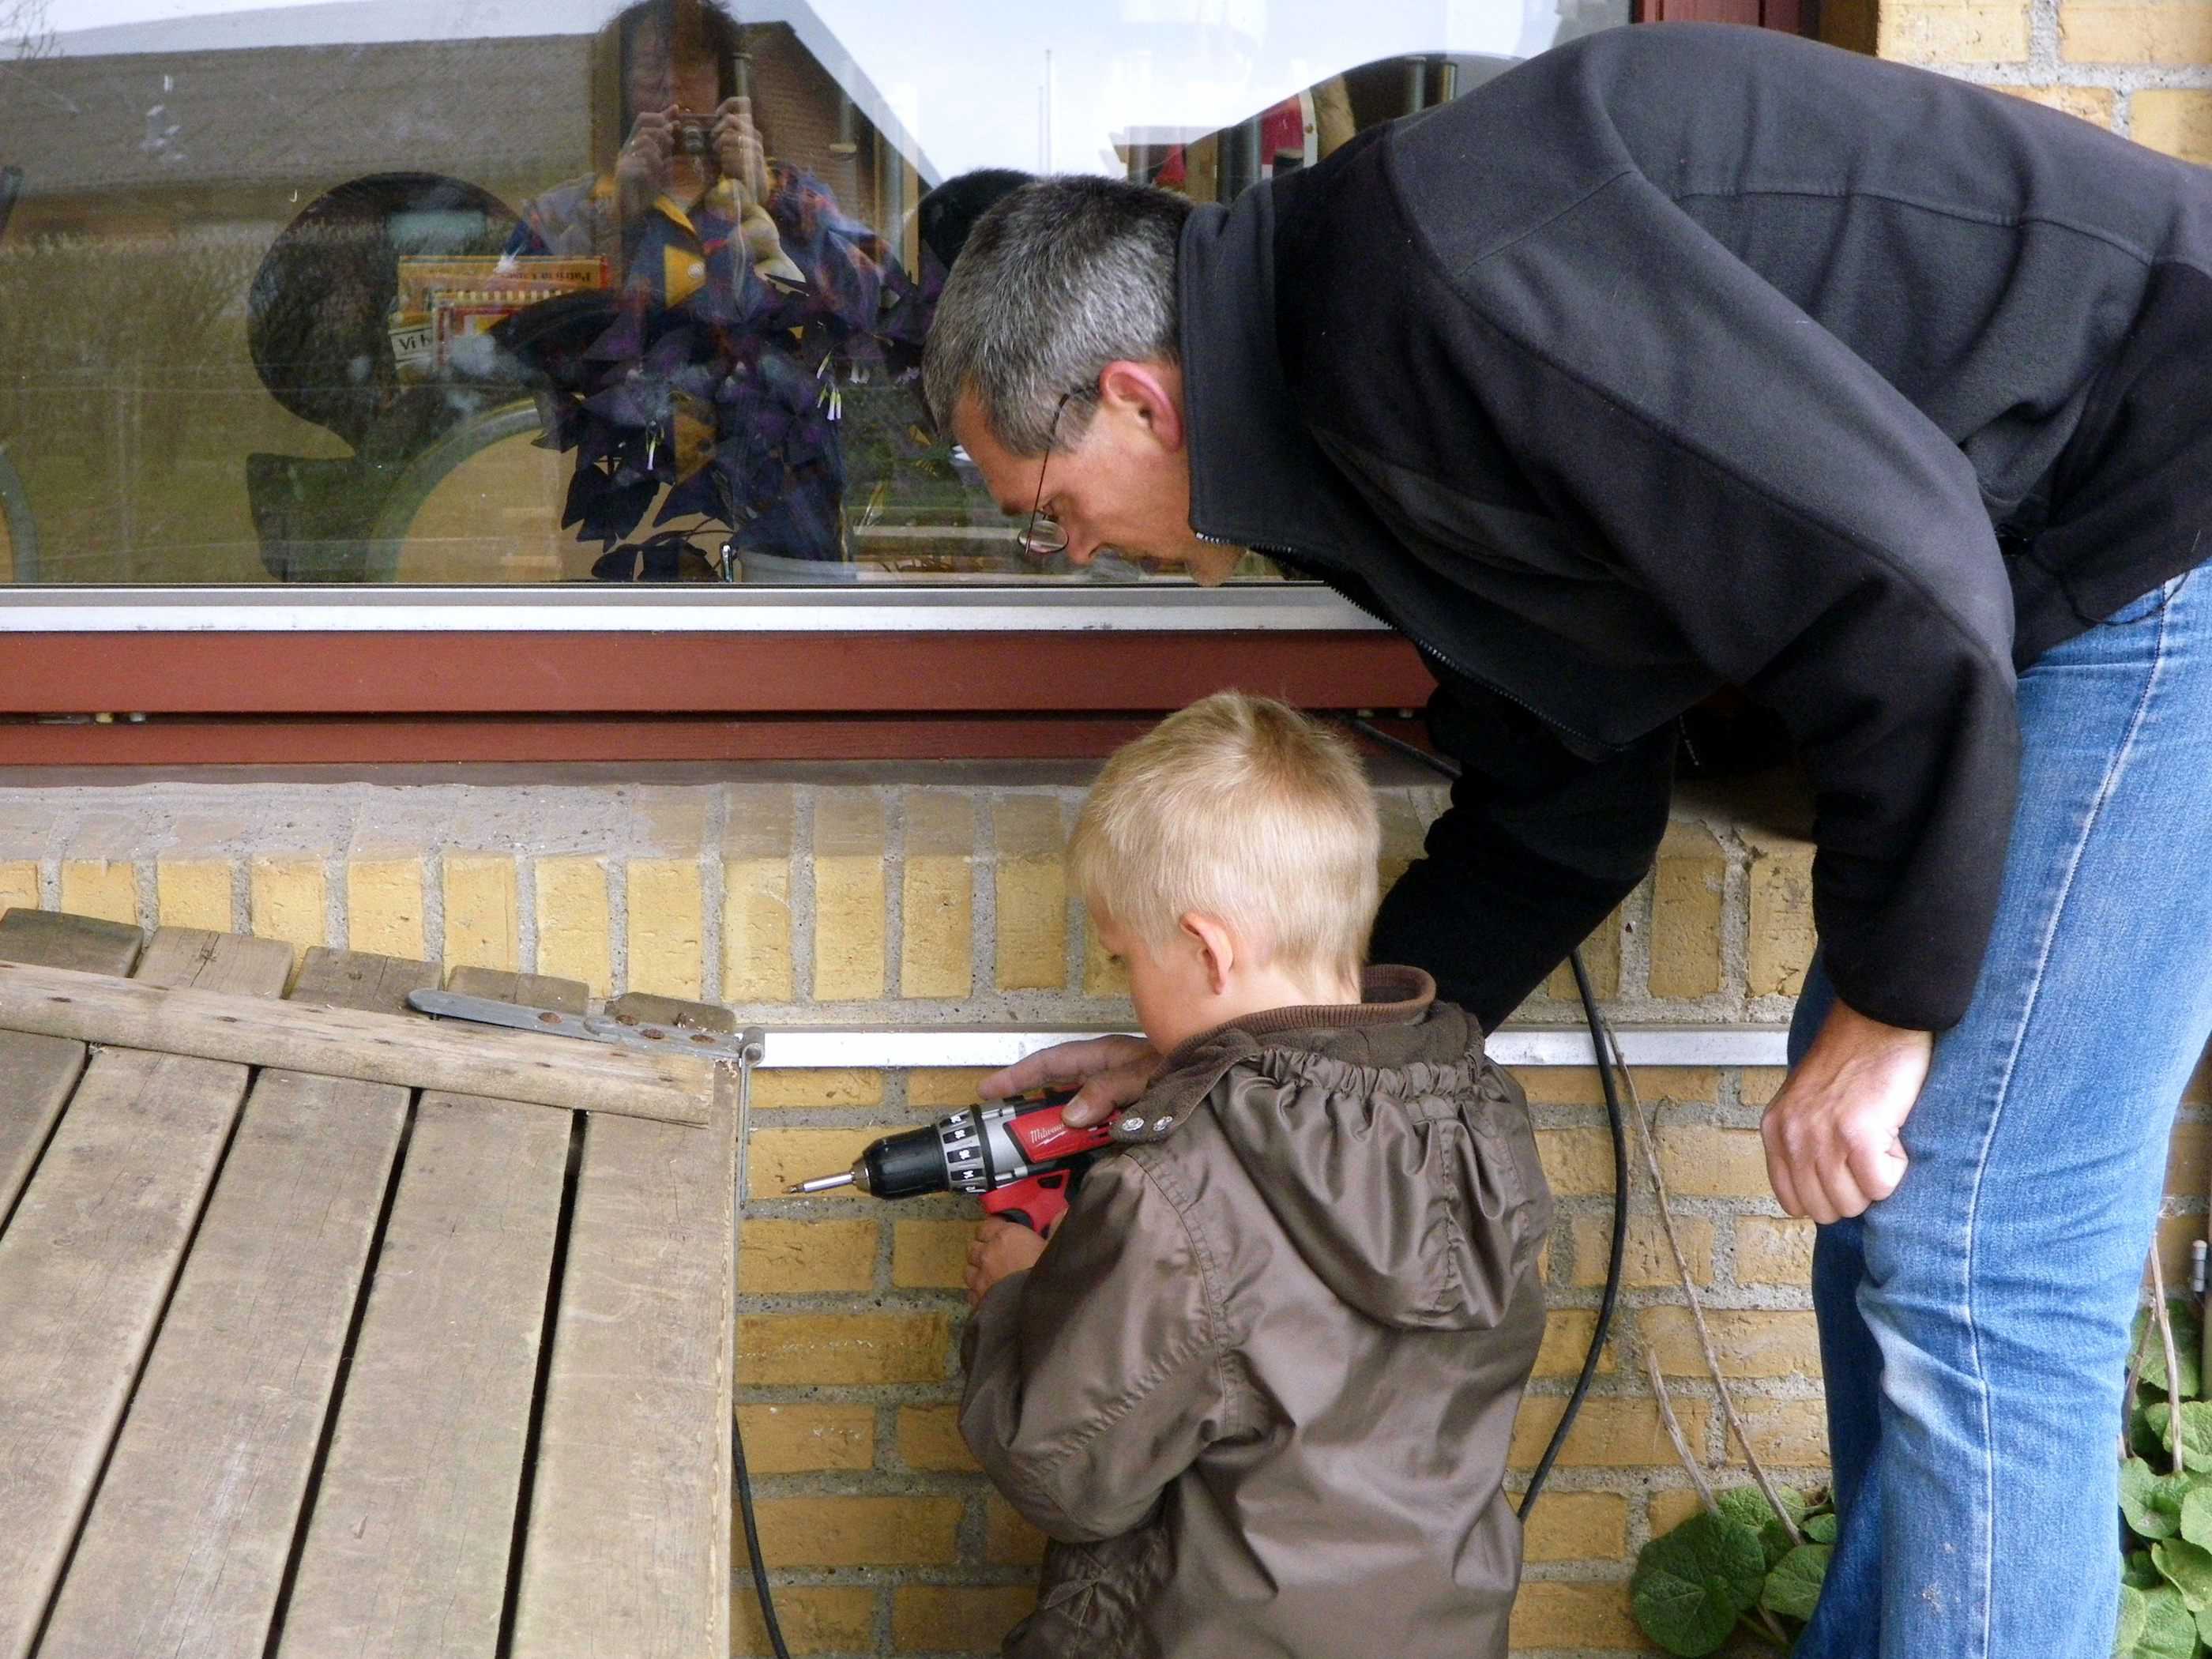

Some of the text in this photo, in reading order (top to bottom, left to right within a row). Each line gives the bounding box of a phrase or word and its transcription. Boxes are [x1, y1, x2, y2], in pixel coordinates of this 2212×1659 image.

[954, 1129, 966, 1139] 18
[1029, 1123, 1066, 1144] Milwau
[958, 1149, 970, 1160] 16
[963, 1170, 974, 1179] 14
